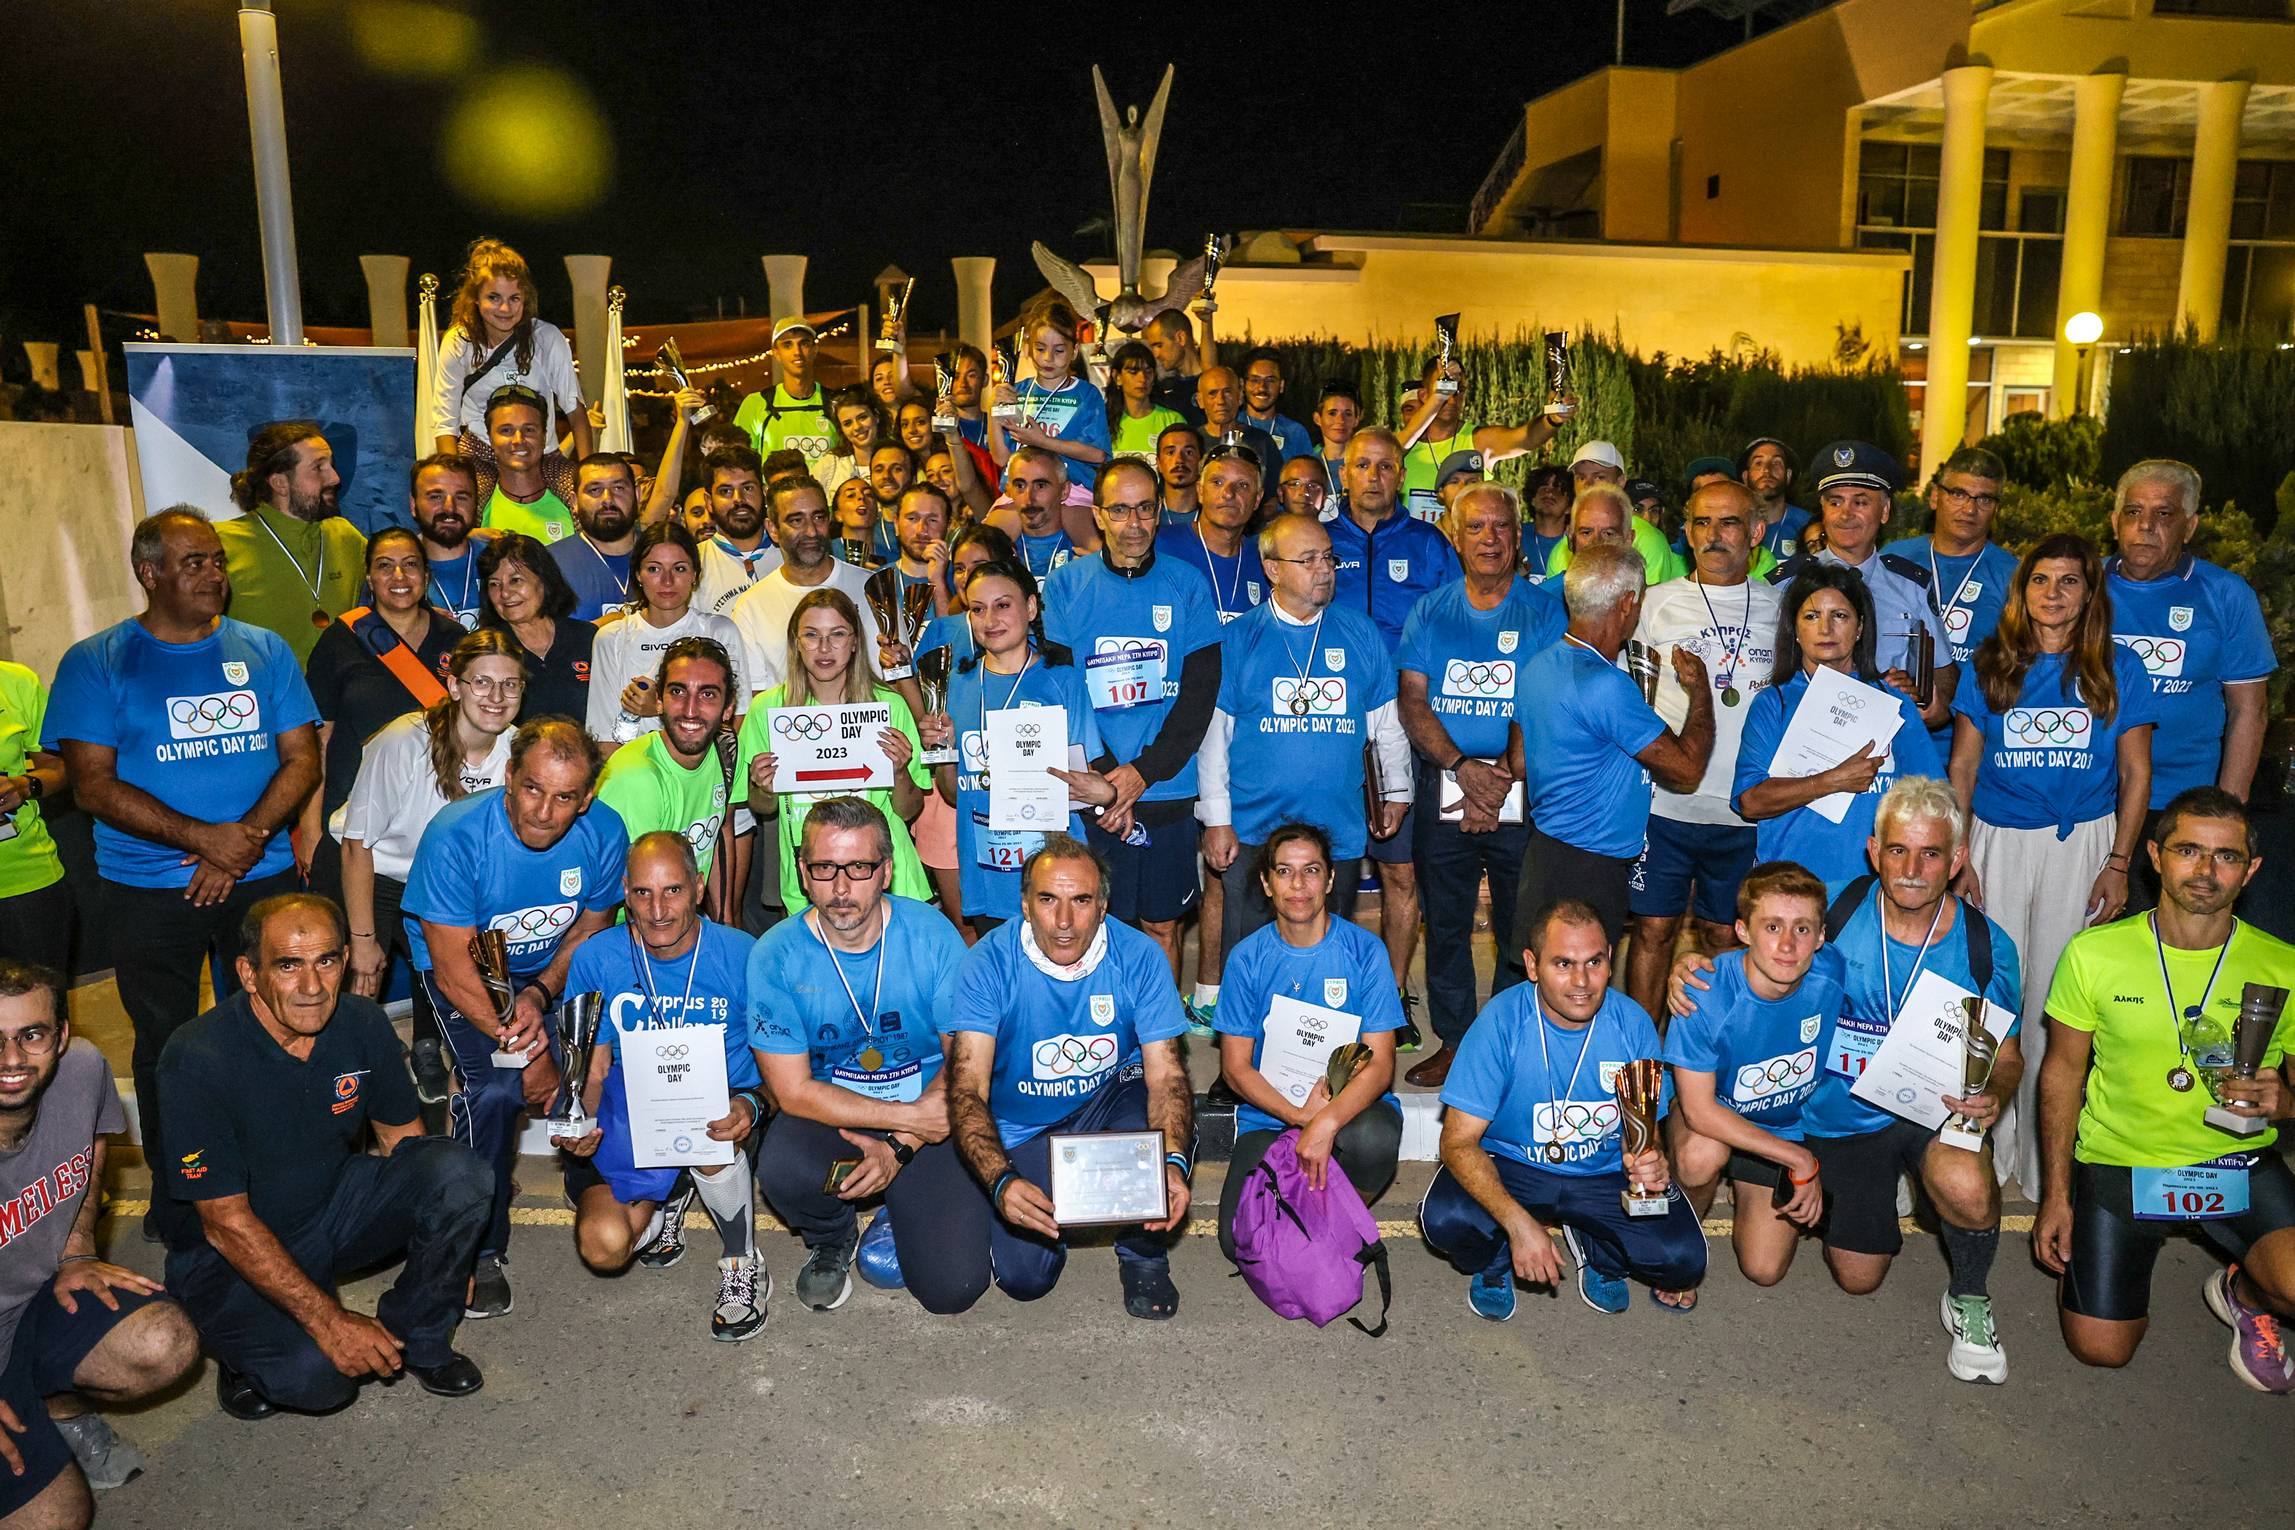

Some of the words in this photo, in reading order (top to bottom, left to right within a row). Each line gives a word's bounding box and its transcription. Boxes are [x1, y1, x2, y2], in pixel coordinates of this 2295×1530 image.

[1700, 626, 1752, 639] ΚΥΠΡΟΣ
[641, 643, 670, 651] GIVO
[1108, 681, 1147, 703] 107
[1162, 681, 1179, 697] 023
[1431, 696, 1473, 716] OLYMPIC
[1475, 700, 1499, 717] DAY
[840, 709, 888, 724] OLYMPIC
[1829, 705, 1858, 723] OLYMPIC
[1260, 717, 1309, 733] OLYMPIC
[1312, 717, 1333, 733] DAY
[1335, 718, 1356, 735] 2023
[1833, 717, 1848, 727] DAY
[841, 726, 862, 739] DAY
[156, 739, 218, 762] OLYMPIC
[221, 736, 246, 754] DAY
[1015, 740, 1041, 749] OLYMPIC
[815, 747, 848, 759] 2023
[1022, 749, 1035, 757] DAY
[1994, 750, 2045, 768] OLYMPIC
[2048, 750, 2073, 767] DAY
[459, 775, 492, 785] VOVA
[988, 847, 1025, 865] 121
[528, 938, 553, 955] DAY
[711, 997, 728, 1008] 20
[2113, 995, 2144, 1004] Άλκης
[711, 1008, 728, 1020] 19
[1856, 1021, 1874, 1032] ΜΕΡΑ
[1875, 1025, 1888, 1034] ΣΤΗ
[1296, 1028, 1325, 1043] OLYMPIC
[1853, 1034, 1876, 1045] OLYMPIC
[1937, 1030, 1954, 1043] DAY
[1302, 1038, 1316, 1048] DAY
[657, 1063, 691, 1074] OLYMPIC
[834, 1068, 870, 1080] ΟΛΥΜΠΙΑΚΗ
[889, 1071, 900, 1079] ΣΤΗ
[900, 1064, 919, 1075] ΚΥΠΡΟ
[667, 1074, 683, 1083] DAY
[1018, 1078, 1076, 1097] OLYMPIC
[1079, 1073, 1102, 1094] DAY
[1772, 1089, 1798, 1108] DAY
[1580, 1140, 1603, 1159] DAY
[2177, 1169, 2205, 1179] OLYMPIC
[2206, 1171, 2218, 1179] DAY
[2162, 1191, 2225, 1213] 102
